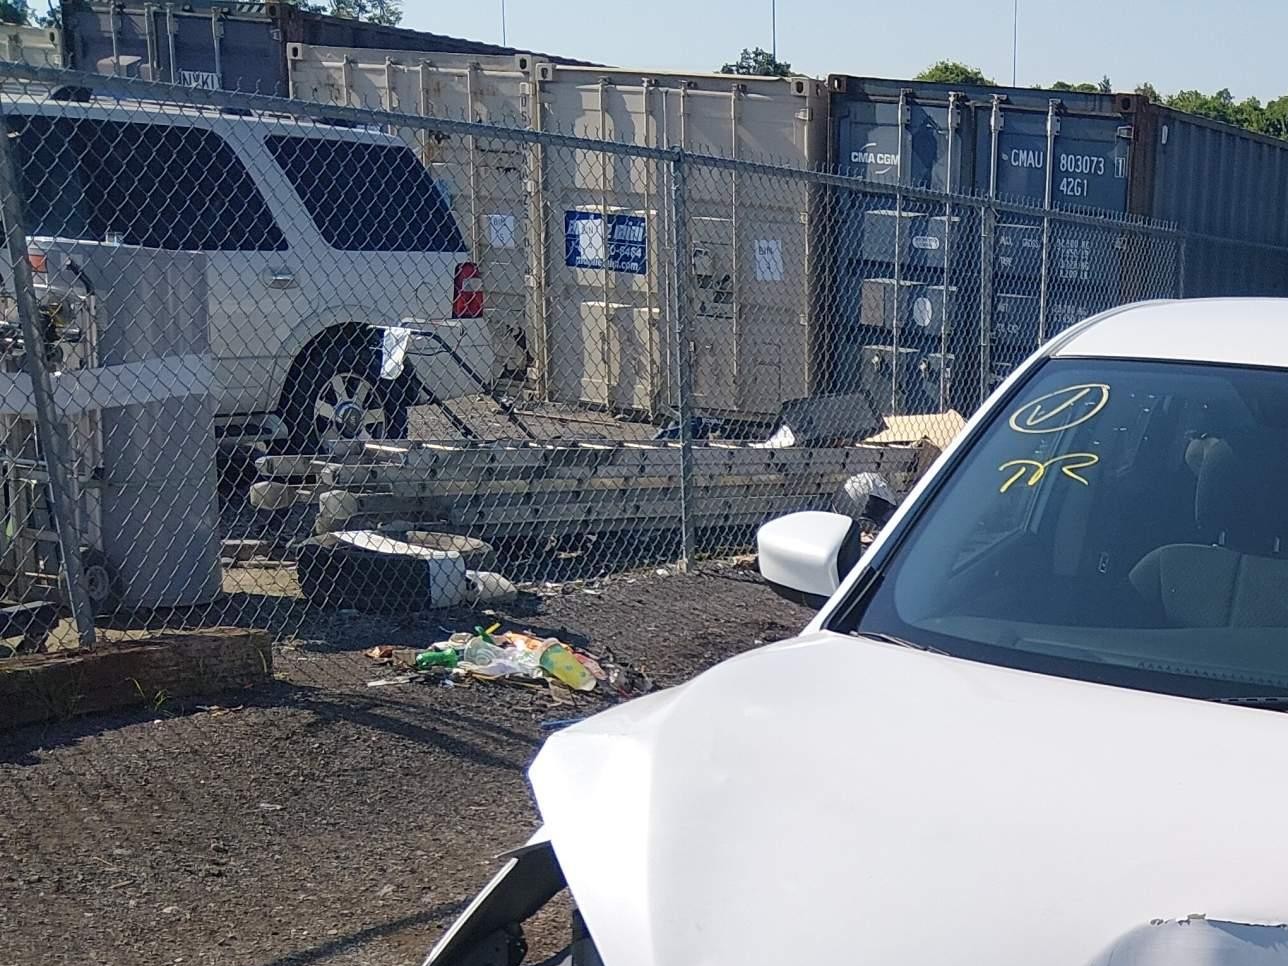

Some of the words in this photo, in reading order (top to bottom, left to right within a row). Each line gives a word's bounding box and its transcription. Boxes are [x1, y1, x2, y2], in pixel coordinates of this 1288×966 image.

[852, 152, 876, 164] CMA
[877, 154, 900, 166] CGM
[1011, 149, 1043, 168] CMAU
[1059, 154, 1105, 175] 803073
[1059, 178, 1088, 196] 42G1
